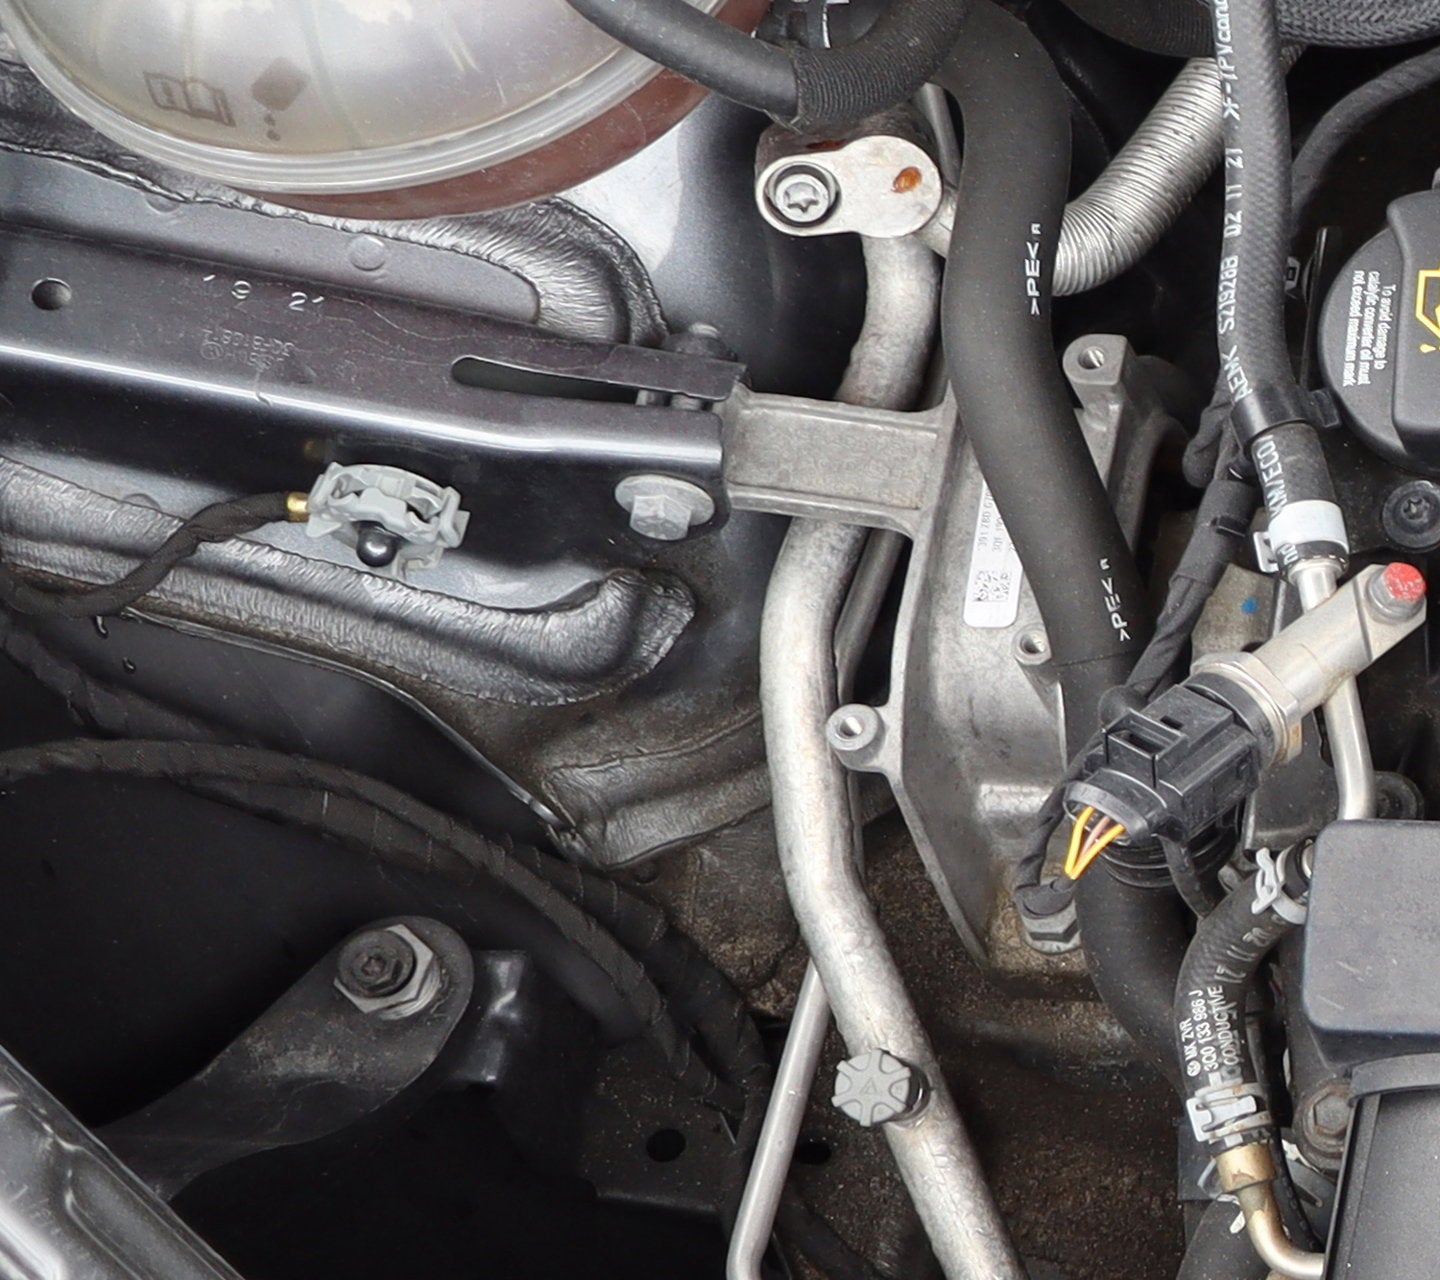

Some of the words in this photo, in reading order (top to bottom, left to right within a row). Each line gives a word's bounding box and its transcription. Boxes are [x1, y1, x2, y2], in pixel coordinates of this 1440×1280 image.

[1352, 271, 1364, 285] not
[1365, 271, 1379, 307] catalytic
[1350, 286, 1362, 318] exceed
[1382, 285, 1395, 296] To
[1379, 297, 1393, 322] avoid
[1360, 307, 1375, 349] converter
[1346, 319, 1359, 362] maximum
[1372, 323, 1390, 360] damage
[1360, 349, 1373, 361] oil
[1374, 361, 1387, 369] to
[1343, 363, 1355, 387] mark
[1357, 361, 1370, 385] must
[1196, 1022, 1212, 1043] 133
[1207, 985, 1239, 1065] CONDUCTIVE
